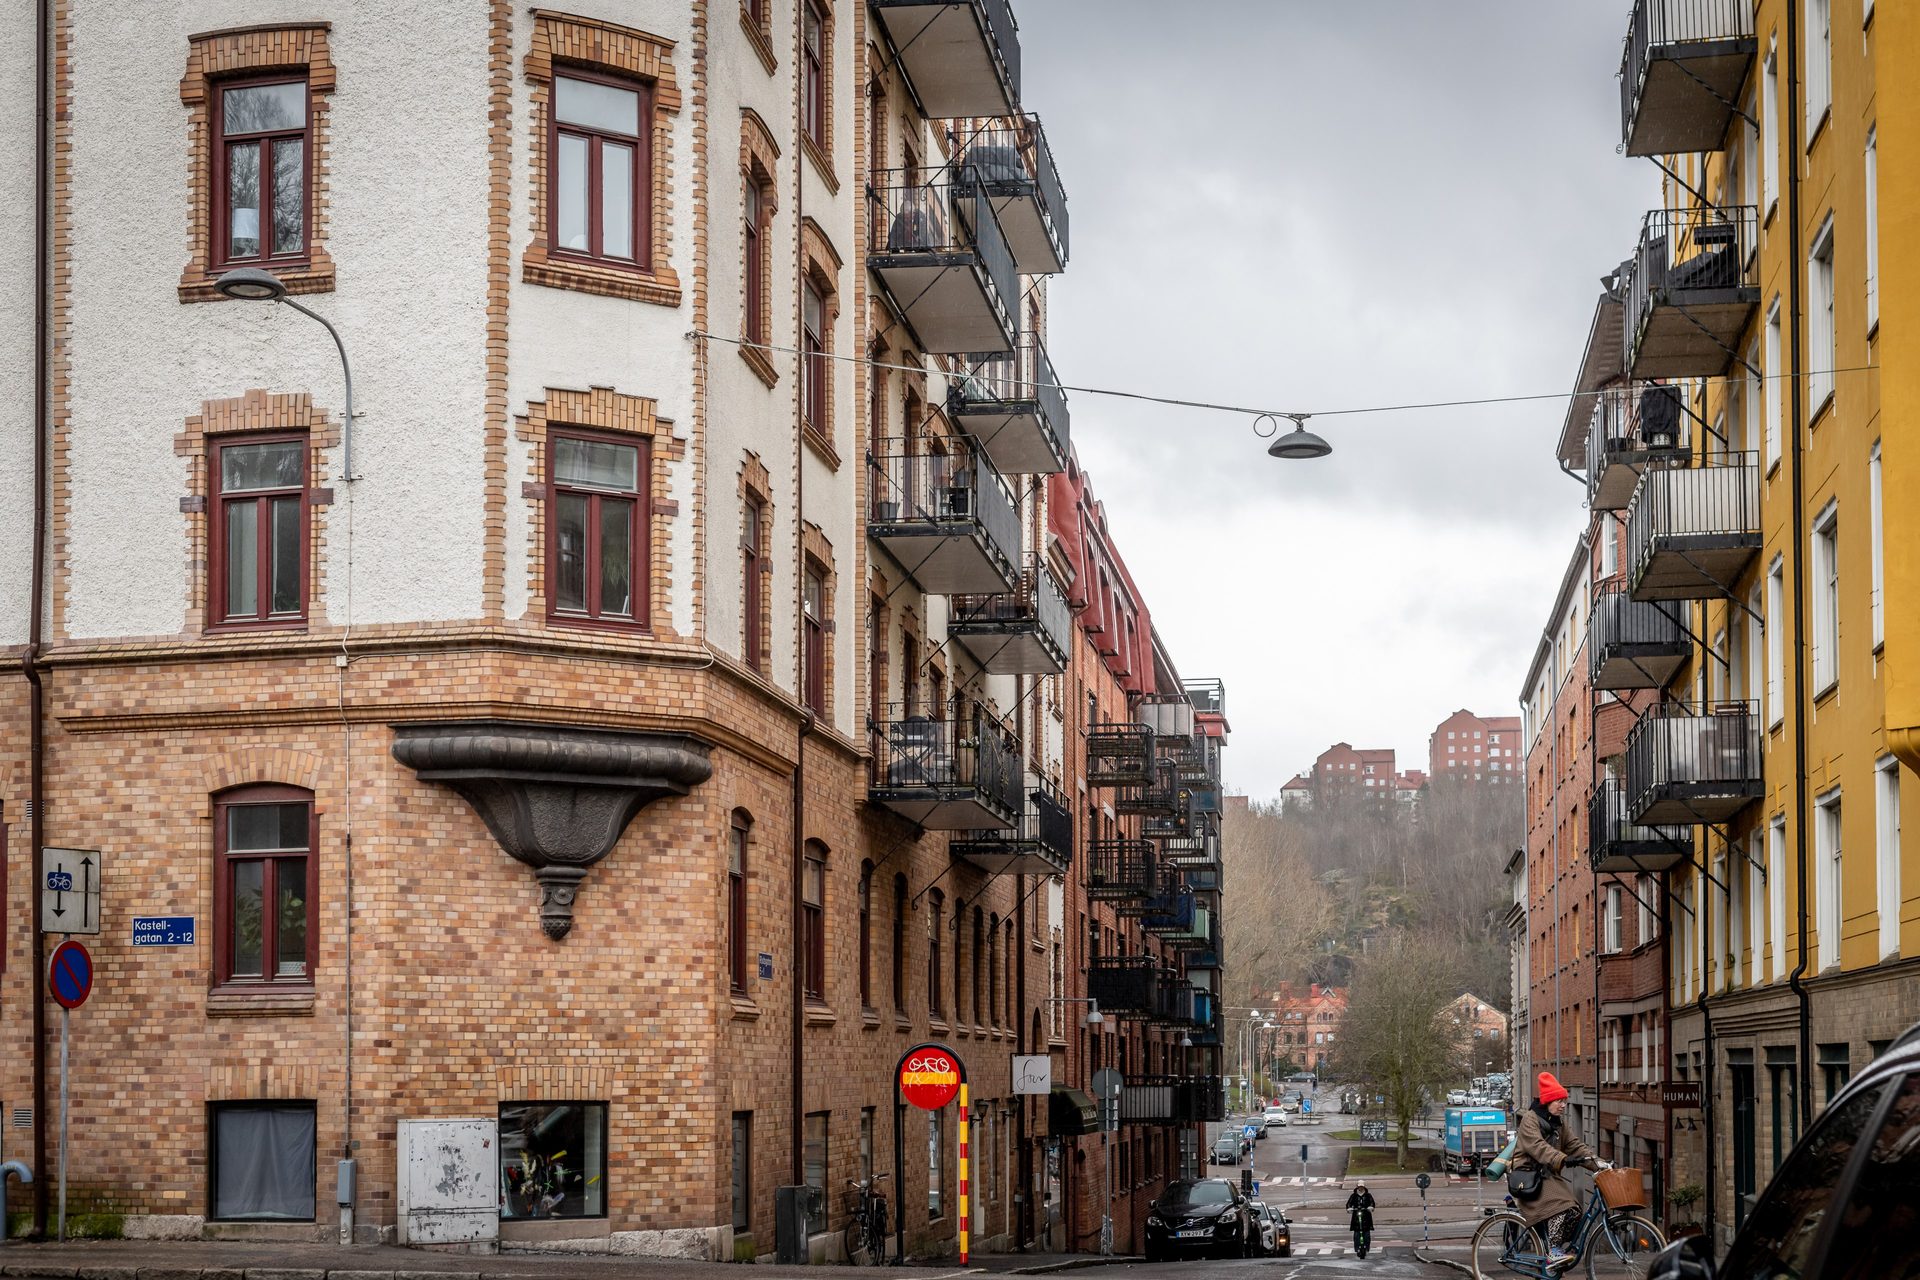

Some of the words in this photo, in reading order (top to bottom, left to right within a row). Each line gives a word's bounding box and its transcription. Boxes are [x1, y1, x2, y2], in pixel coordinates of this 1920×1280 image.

[135, 920, 171, 930] Kastell-
[135, 933, 162, 945] gatan
[1663, 1092, 1698, 1101] HUMAN
